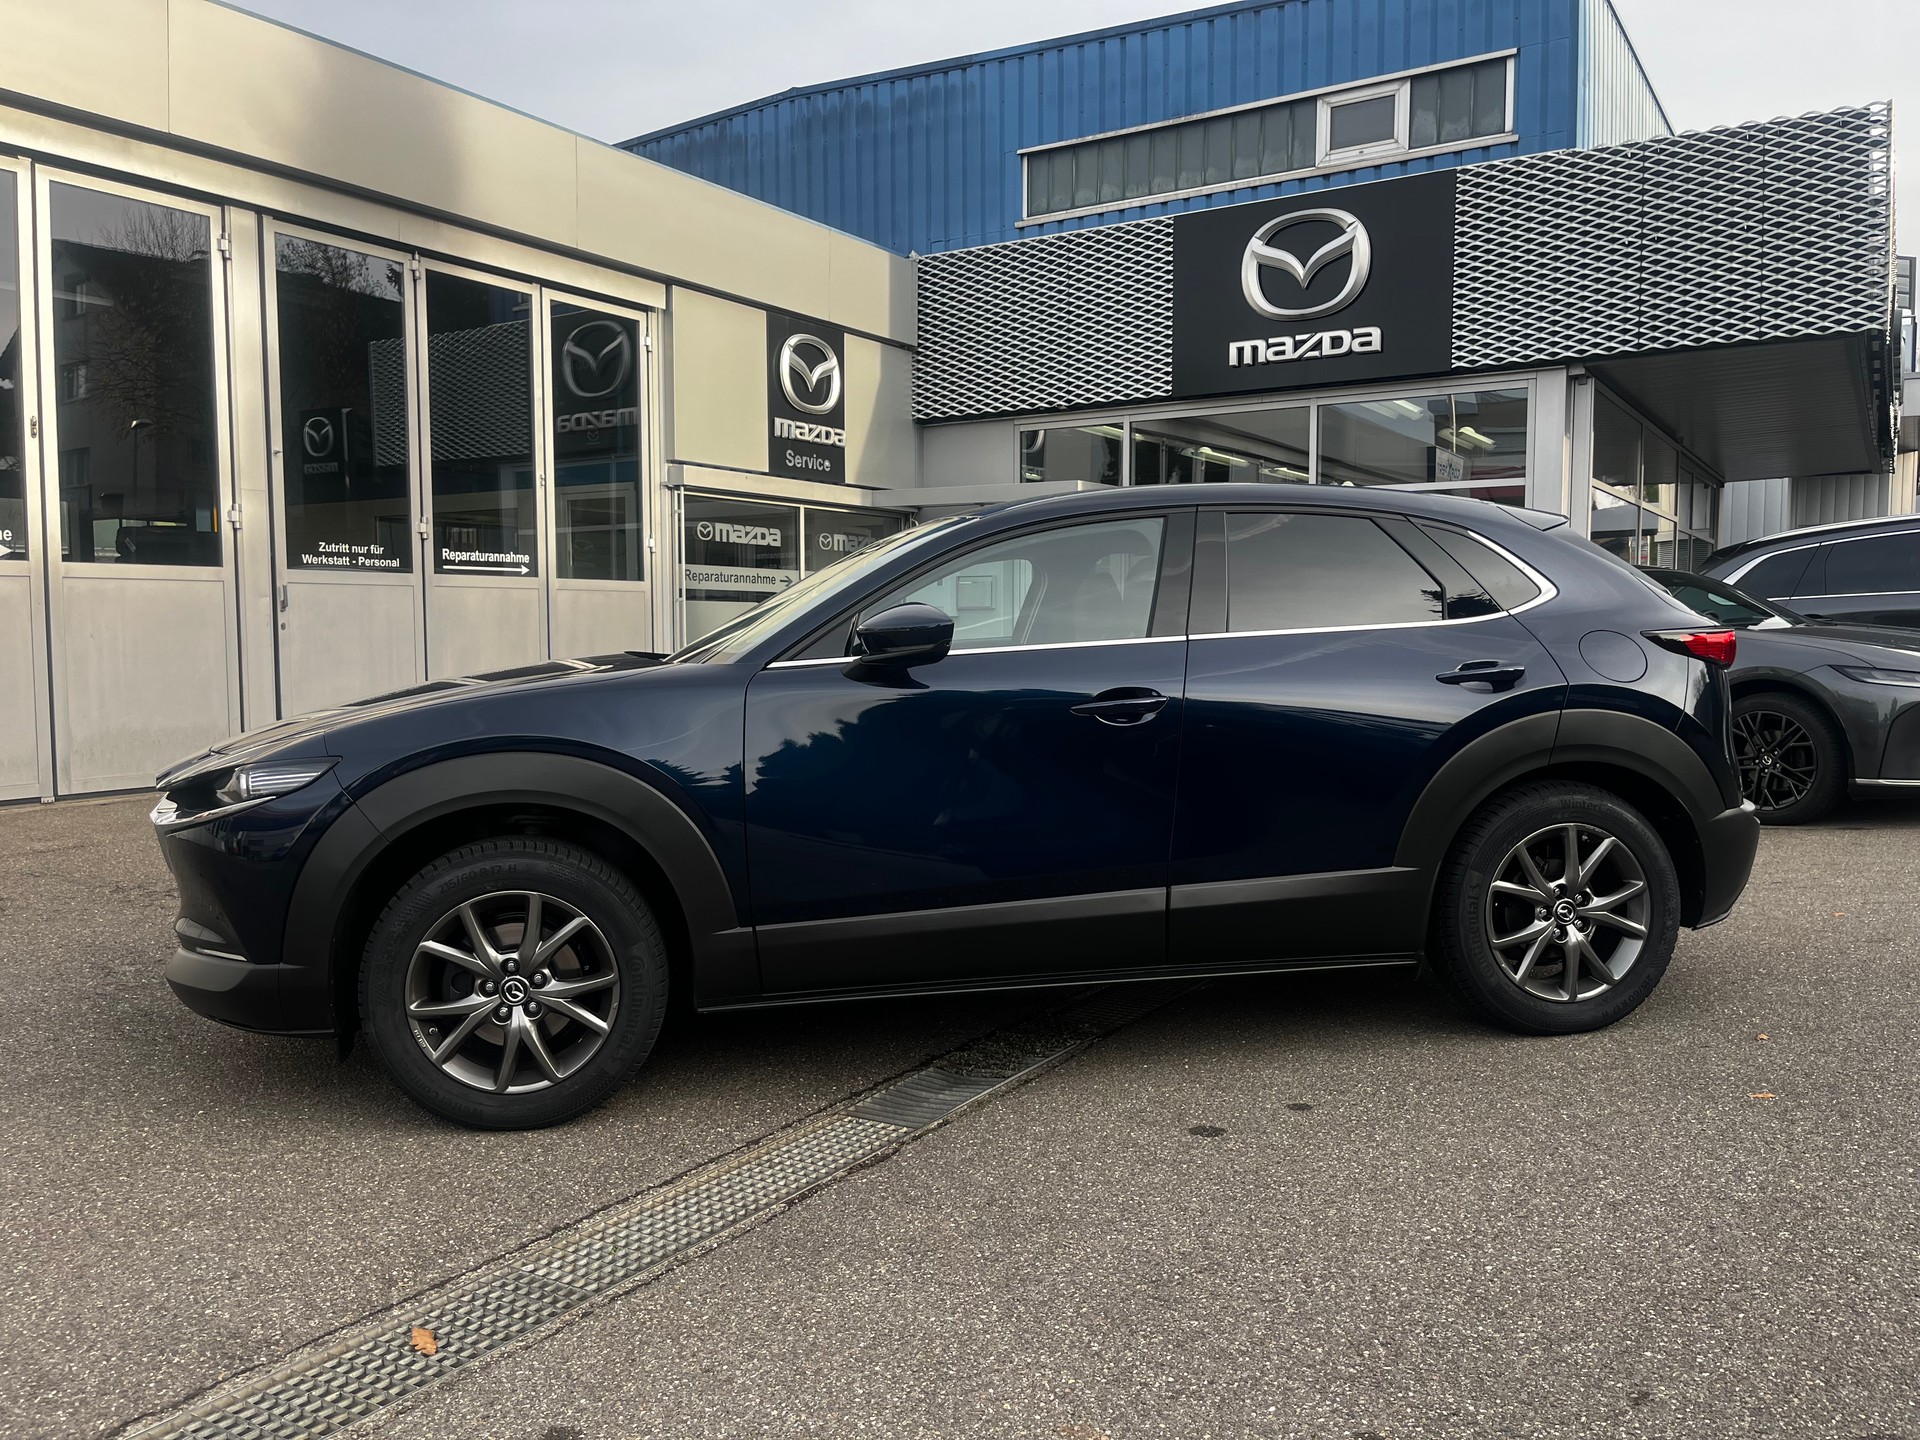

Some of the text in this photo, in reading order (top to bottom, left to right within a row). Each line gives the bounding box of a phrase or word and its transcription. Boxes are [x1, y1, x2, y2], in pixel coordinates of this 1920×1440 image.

[1228, 326, 1382, 368] mazda
[774, 416, 847, 448] mazda
[785, 449, 831, 472] Service
[715, 522, 782, 547] mazda
[834, 533, 879, 551] maz
[318, 541, 385, 555] Zutritt nur für
[442, 548, 530, 564] Reparaturannahme
[301, 553, 350, 566] Werkstatt
[358, 557, 400, 568] Personal
[685, 569, 776, 586] Reparaturannahme
[616, 955, 648, 1051] Continental
